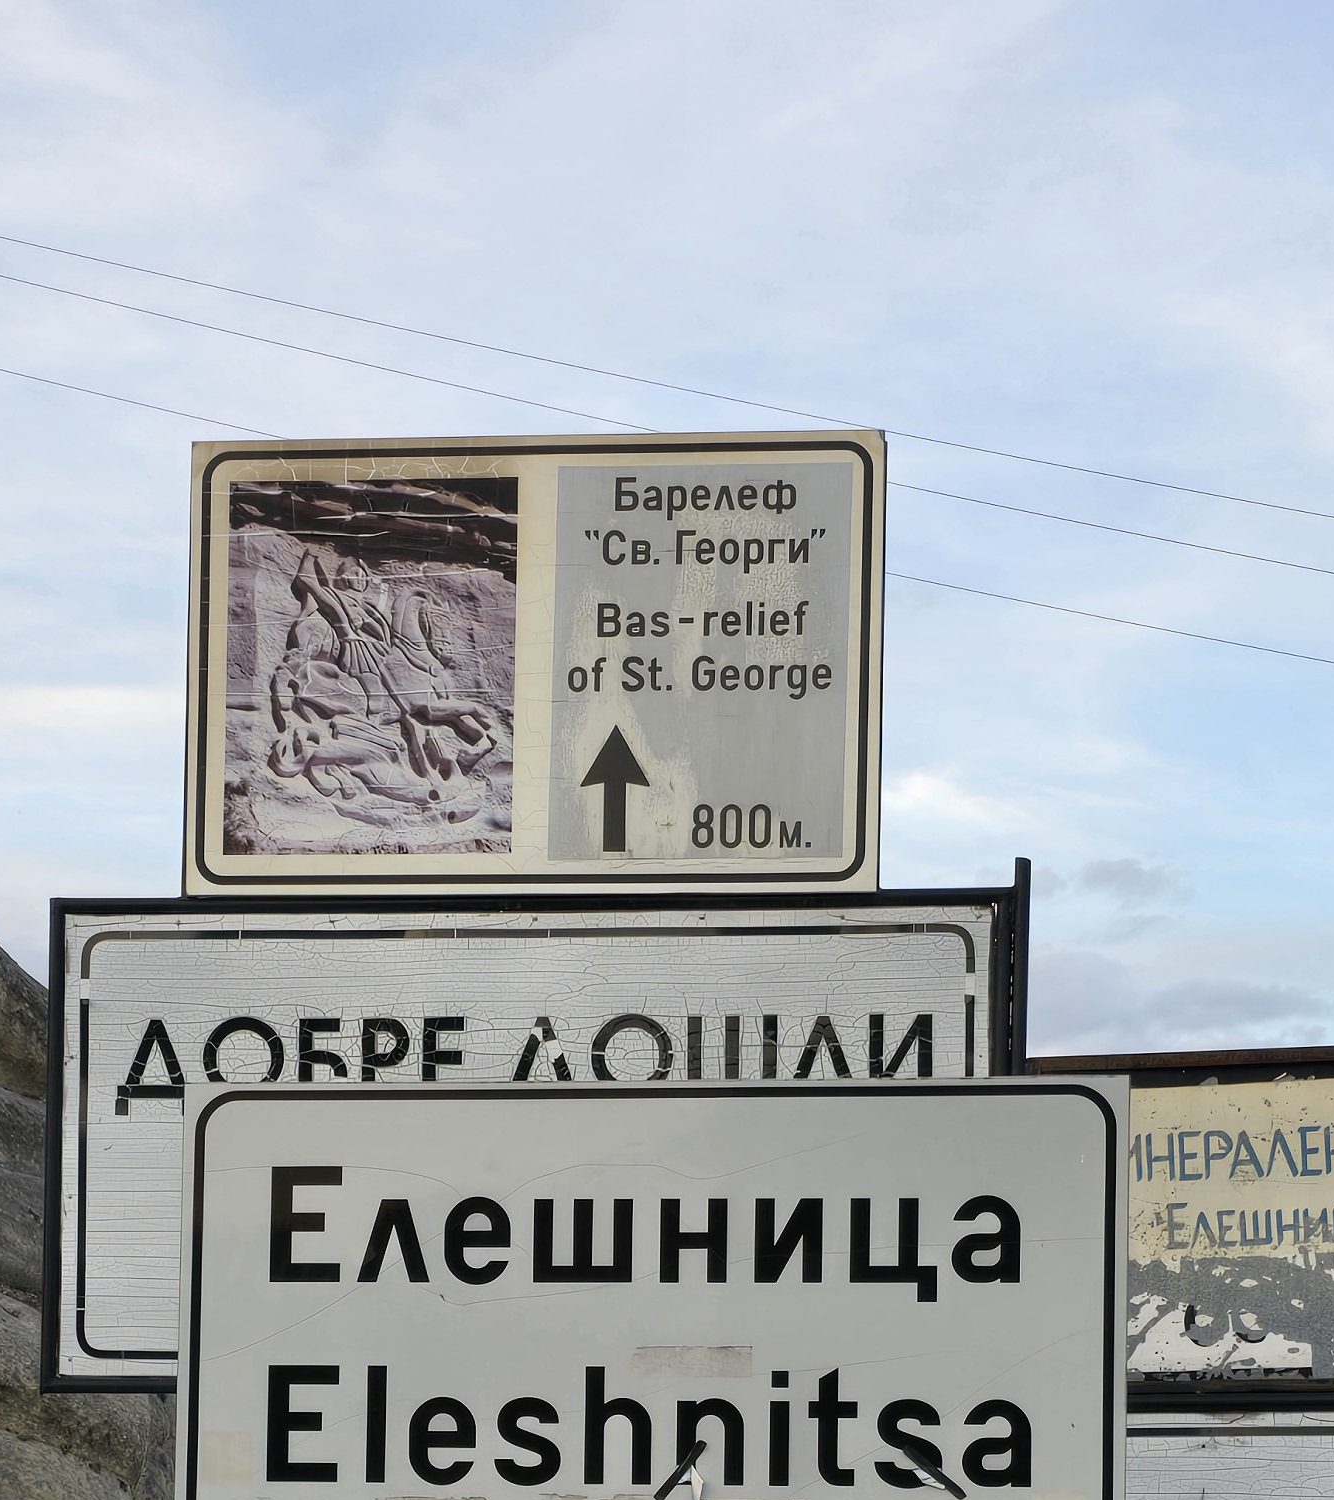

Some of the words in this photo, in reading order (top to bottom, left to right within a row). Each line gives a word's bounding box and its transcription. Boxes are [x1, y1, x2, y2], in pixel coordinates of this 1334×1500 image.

[614, 476, 797, 521] Барелеф
[567, 656, 606, 693] of
[621, 655, 673, 693] St.
[691, 655, 832, 701] George
[269, 1165, 1021, 1302] Елешница
[266, 1364, 1032, 1488] Eleshnitsa
